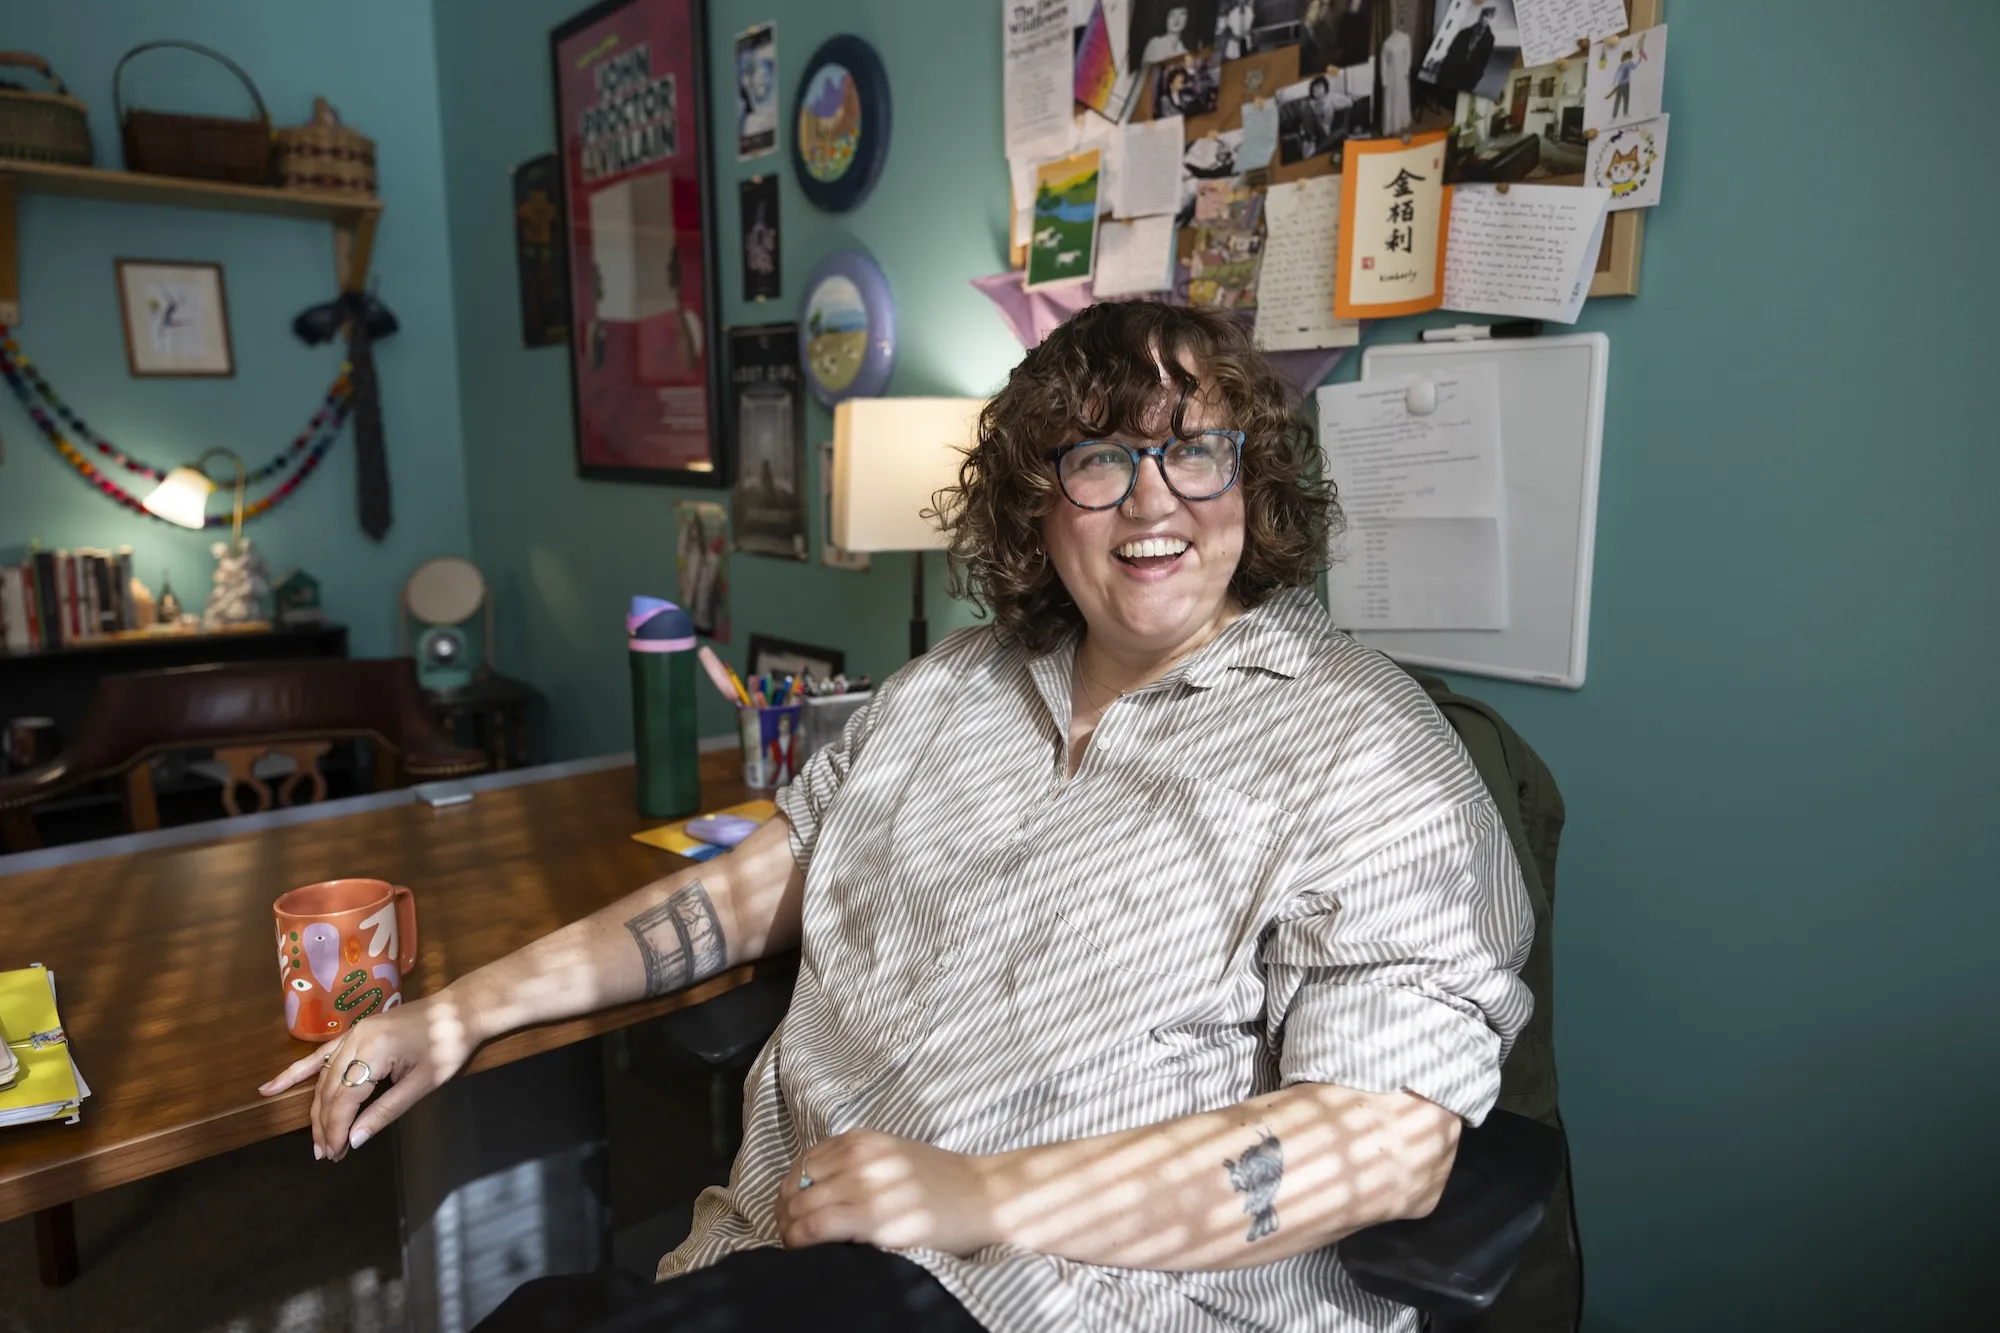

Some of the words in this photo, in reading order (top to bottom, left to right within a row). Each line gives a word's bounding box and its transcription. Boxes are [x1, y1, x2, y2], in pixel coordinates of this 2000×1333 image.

[600, 46, 649, 99] JOHN
[582, 81, 672, 138] PROCTOR
[608, 120, 676, 173] VILLAIN
[732, 364, 763, 382] LOST
[767, 363, 797, 381] GIRL
